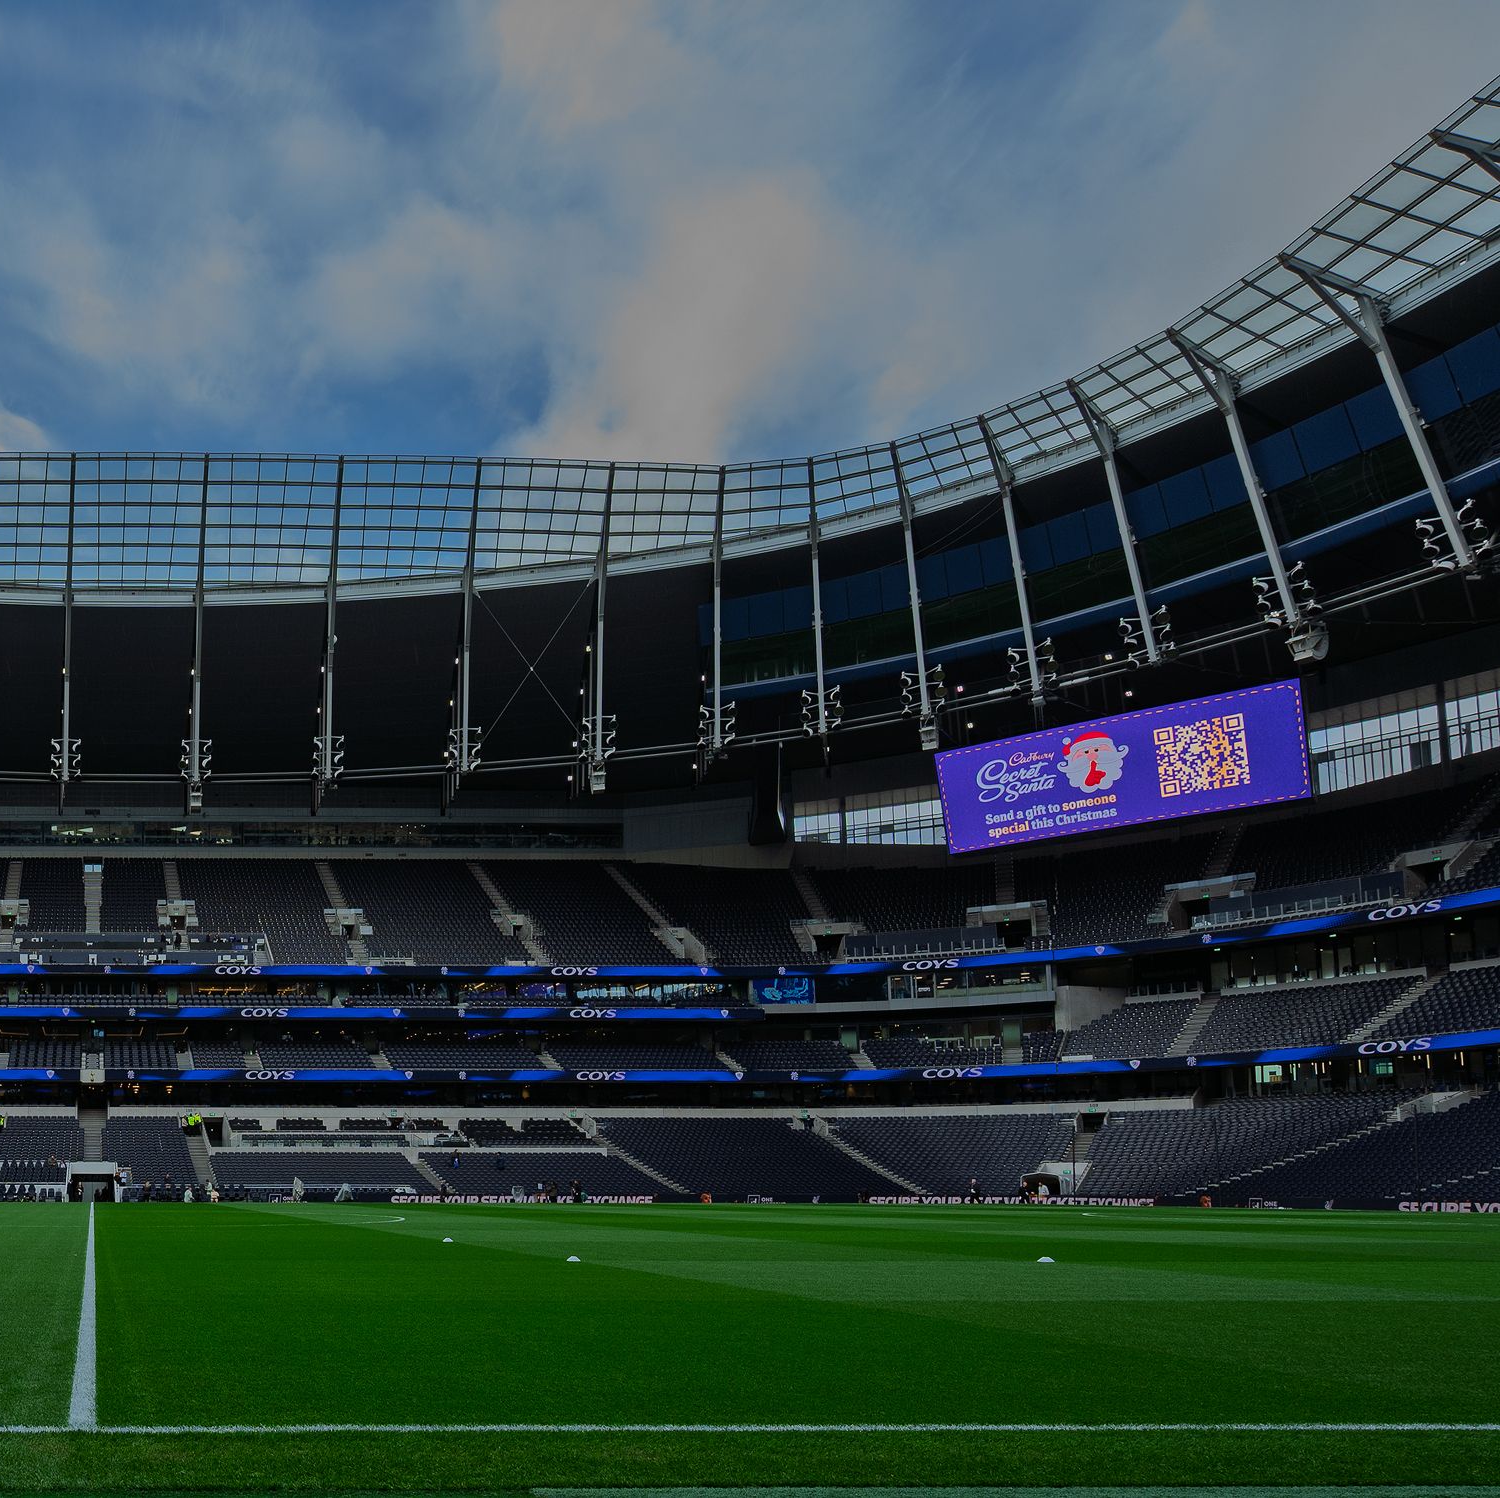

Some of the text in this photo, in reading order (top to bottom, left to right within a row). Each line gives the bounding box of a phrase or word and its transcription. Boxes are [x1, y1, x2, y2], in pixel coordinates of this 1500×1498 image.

[1008, 751, 1055, 767] Cadbury
[976, 759, 1049, 803] Secret
[1004, 774, 1057, 803] Santa
[985, 794, 1117, 825] Send a gift to someone
[988, 807, 1118, 838] special this Christmas
[1367, 898, 1442, 922] COYS
[215, 965, 263, 975] COYS
[551, 966, 598, 976] COYS
[902, 958, 960, 972] COYS
[241, 1006, 289, 1018] COYS
[569, 1008, 617, 1019] COYS
[1358, 1036, 1432, 1055] COYS
[245, 1070, 296, 1080] COYS
[576, 1070, 626, 1081] COYS
[922, 1065, 984, 1079] COYS
[1398, 1201, 1500, 1214] SECURE YO
